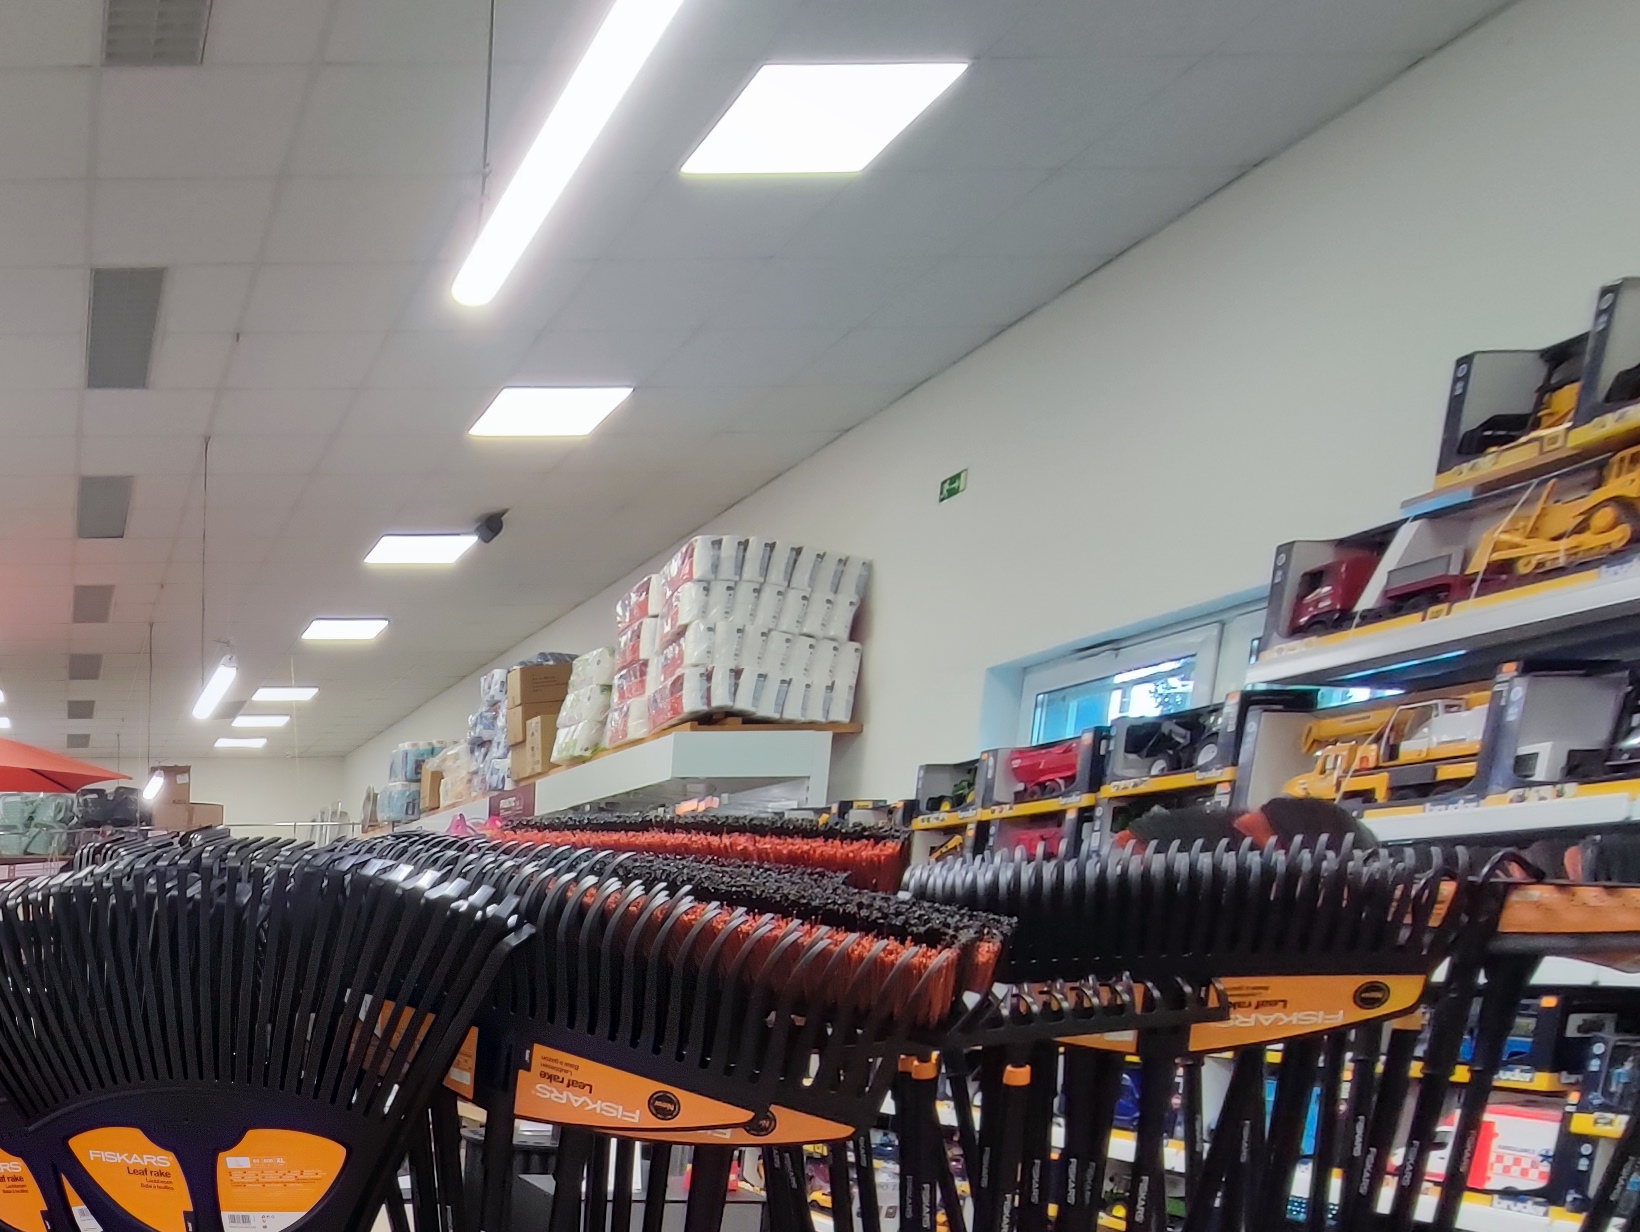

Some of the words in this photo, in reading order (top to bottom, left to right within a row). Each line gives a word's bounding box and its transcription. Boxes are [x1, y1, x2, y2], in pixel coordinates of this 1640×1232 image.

[1227, 1001, 1252, 1011] rak
[539, 1070, 565, 1086] rake
[567, 1081, 593, 1094] Leaf
[534, 1083, 641, 1123] FISKARS
[1352, 1115, 1365, 1158] FISKARS
[7, 1174, 25, 1182] rake
[88, 1149, 171, 1167] FISKARS
[126, 1166, 148, 1176] Leaf
[150, 1169, 171, 1178] rake
[1359, 1146, 1378, 1196] FISKARS
[1401, 1139, 1421, 1188] FISKARS
[1031, 1158, 1041, 1205] FISKARS
[1067, 1158, 1078, 1206] FISKARS
[1133, 1175, 1150, 1225] FISKARS
[920, 1183, 932, 1230] FISKARS
